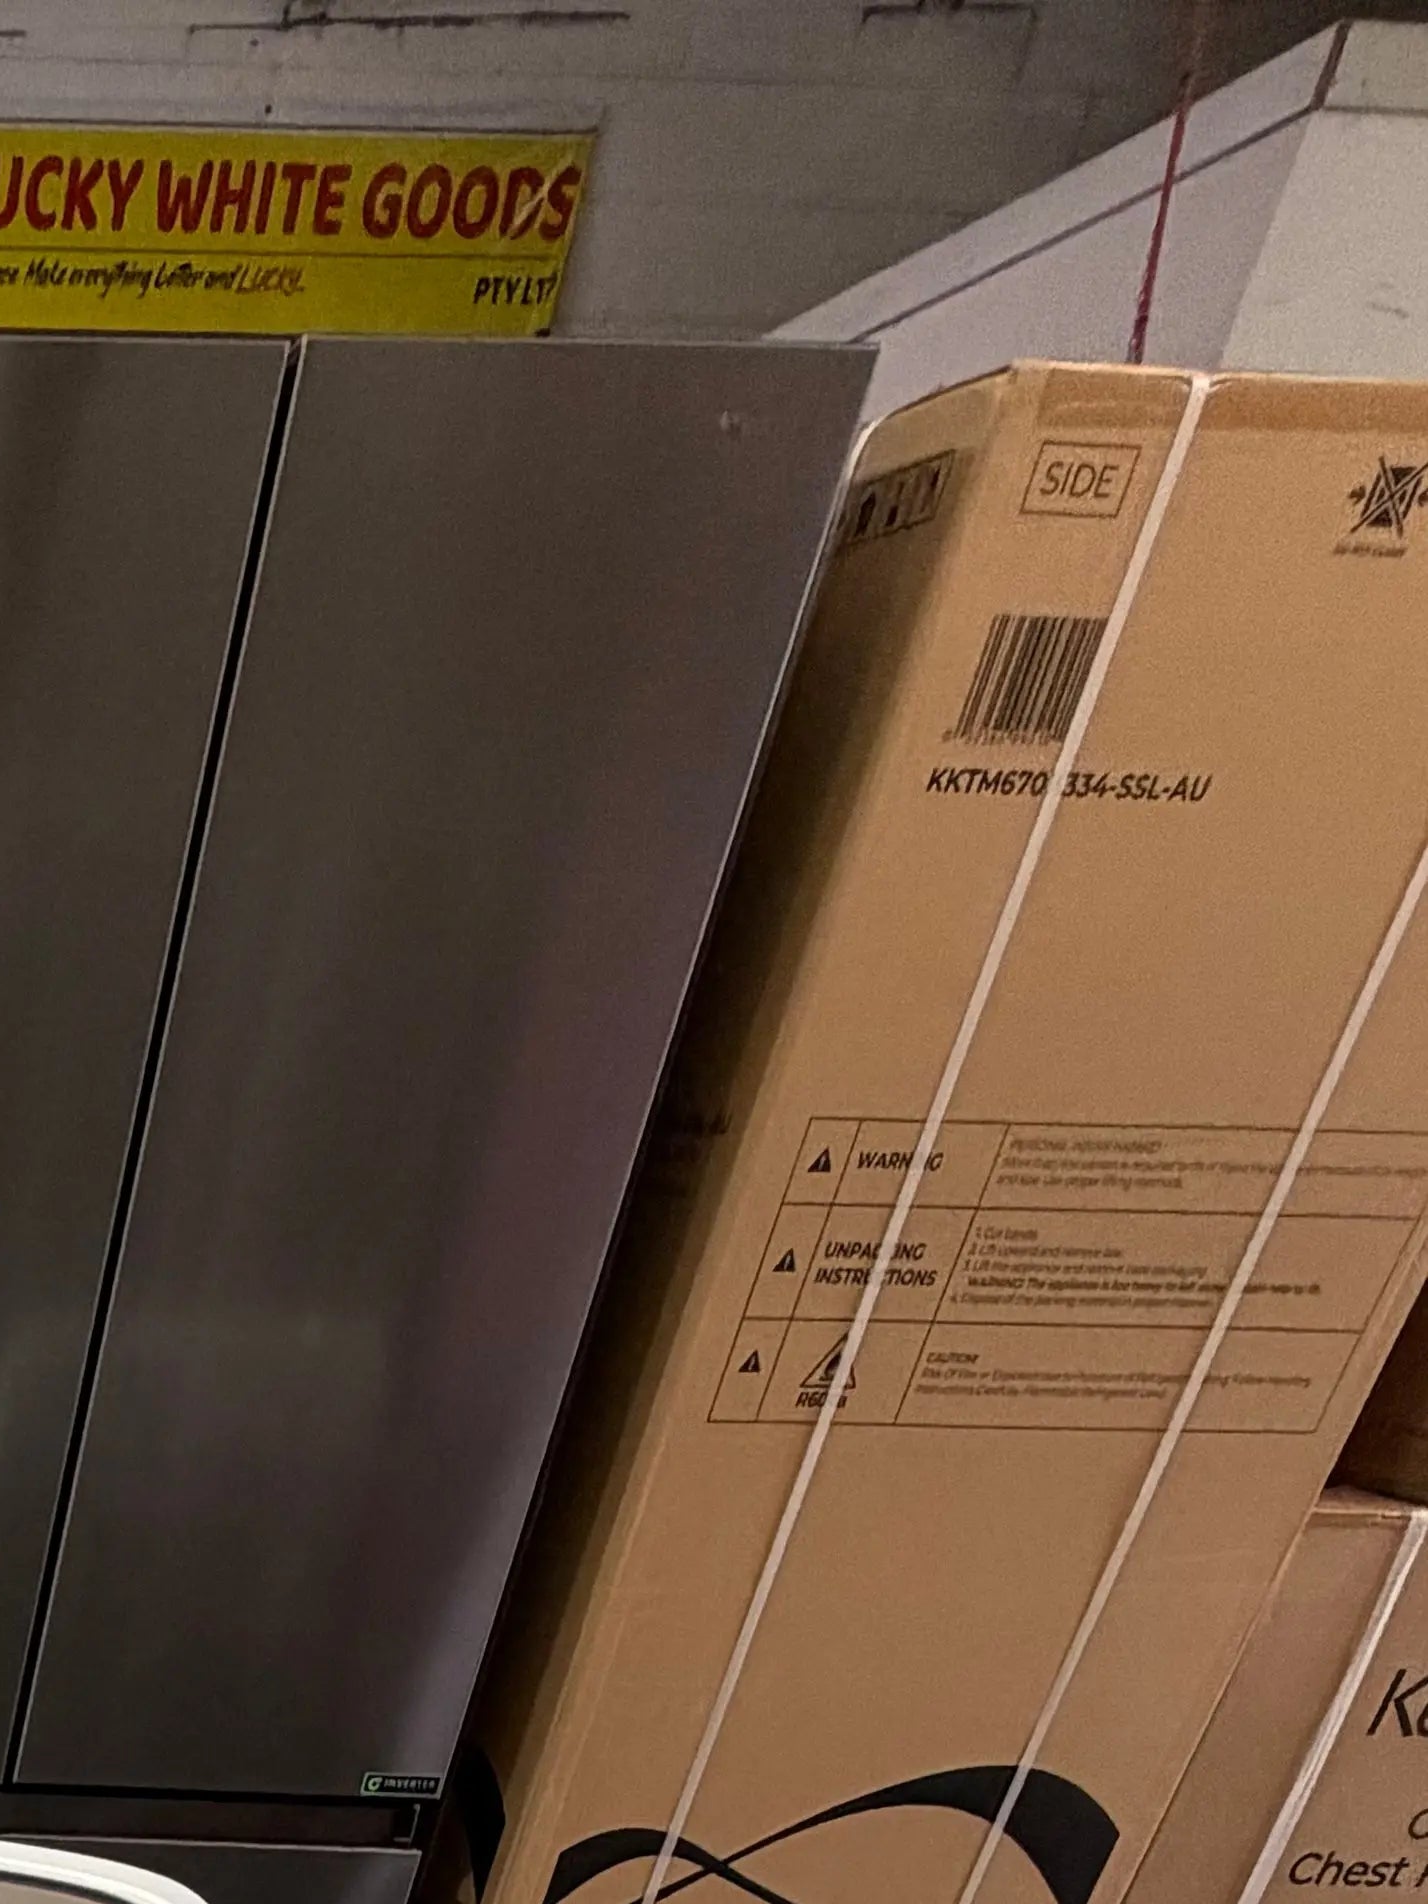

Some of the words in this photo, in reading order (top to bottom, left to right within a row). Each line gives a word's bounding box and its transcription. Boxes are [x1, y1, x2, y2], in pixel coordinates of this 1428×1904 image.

[156, 157, 352, 236] WHITE
[360, 161, 582, 243] GOODS
[473, 275, 521, 305] PTY
[1039, 461, 1120, 499] SIDE
[926, 767, 1213, 803] KKTM670334-SSL-AU
[1288, 1851, 1410, 1888] Chest
